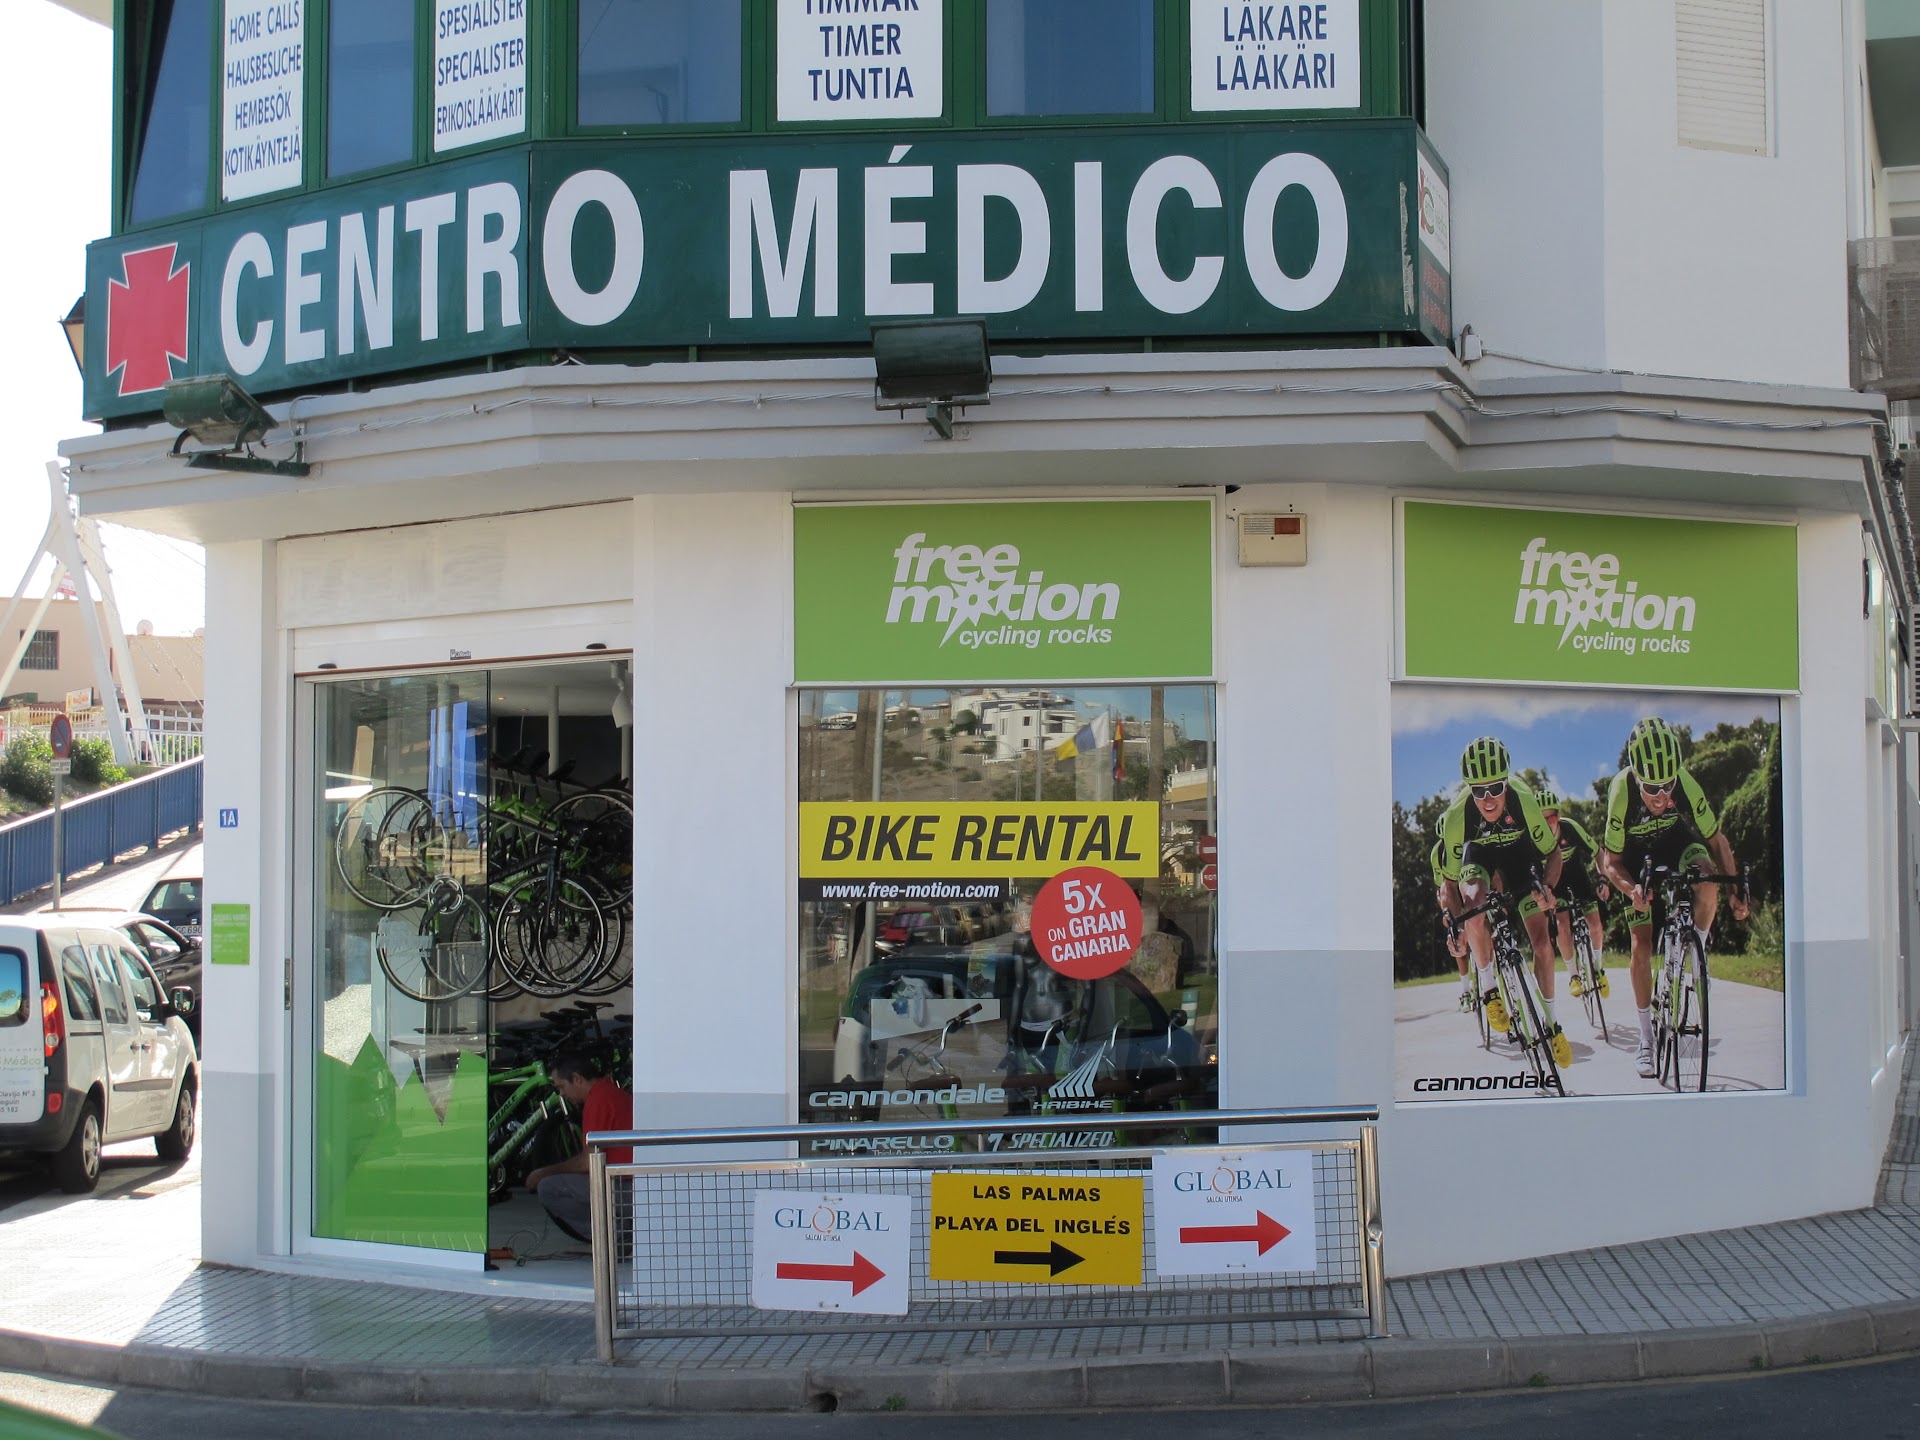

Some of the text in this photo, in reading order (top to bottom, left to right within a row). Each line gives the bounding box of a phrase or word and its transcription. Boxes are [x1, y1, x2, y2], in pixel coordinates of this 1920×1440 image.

[230, 0, 300, 45] HOME CALLS
[439, 0, 523, 39] SPESIALISTER
[819, 24, 902, 57] TIMER
[227, 44, 301, 89] HAUSBESUCHE
[438, 38, 524, 86] SPECIALISTER
[1216, 43, 1335, 91] LÄÄKÄRI
[808, 66, 914, 101] TUNTIA
[235, 85, 291, 131] HEMBESÖK
[437, 82, 524, 135] ERIKOISLÄÄKÄRIT
[224, 125, 300, 177] KOTIKÄYNTEJÄ
[221, 145, 1348, 376] CENTRO MÉDICO
[894, 533, 1020, 582] free
[1520, 537, 1619, 588] free
[886, 571, 1119, 622] motion
[1514, 582, 1696, 631] motion
[959, 624, 1112, 649] cycling rocks
[1573, 632, 1690, 655] cycling rocks
[222, 811, 235, 825] 1A
[821, 815, 1141, 861] BIKE RENTAL
[822, 881, 999, 898] www.free-motion.com
[1048, 910, 1127, 942] ON GRAN
[1051, 934, 1131, 963] CANARIA
[809, 1084, 1006, 1107] cannondale
[1413, 1070, 1558, 1092] cannondale
[1033, 1100, 1114, 1110] HAIBIKE
[811, 1131, 1114, 1151] PINARELLO SPECIALIZED
[974, 1186, 1100, 1202] LAS PALMAS
[1174, 1166, 1292, 1194] GLOBAL
[775, 1205, 890, 1232] GLOBAL
[935, 1215, 1131, 1235] PLAYA DEL INGLÉS
